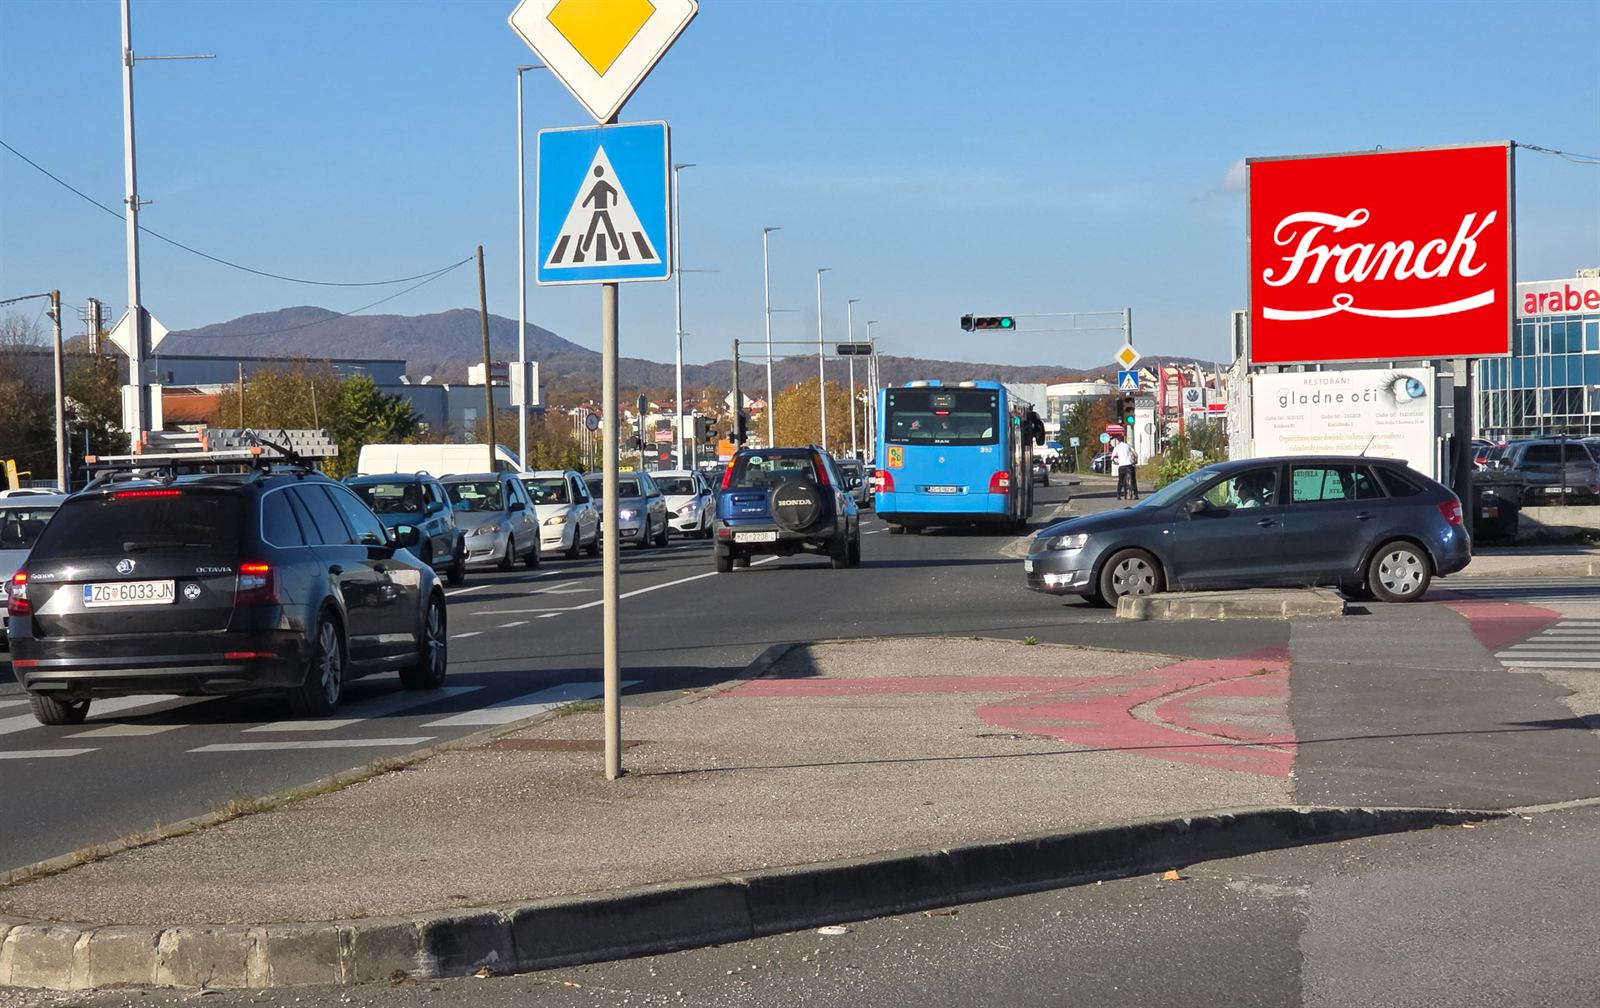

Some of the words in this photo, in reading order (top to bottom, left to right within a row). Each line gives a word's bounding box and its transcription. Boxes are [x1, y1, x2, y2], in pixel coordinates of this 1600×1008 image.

[1262, 207, 1498, 287] Franck
[1303, 378, 1350, 386] RESTORANI
[1279, 390, 1344, 408] gladne
[1351, 388, 1377, 403] oči
[94, 586, 111, 601] ZG
